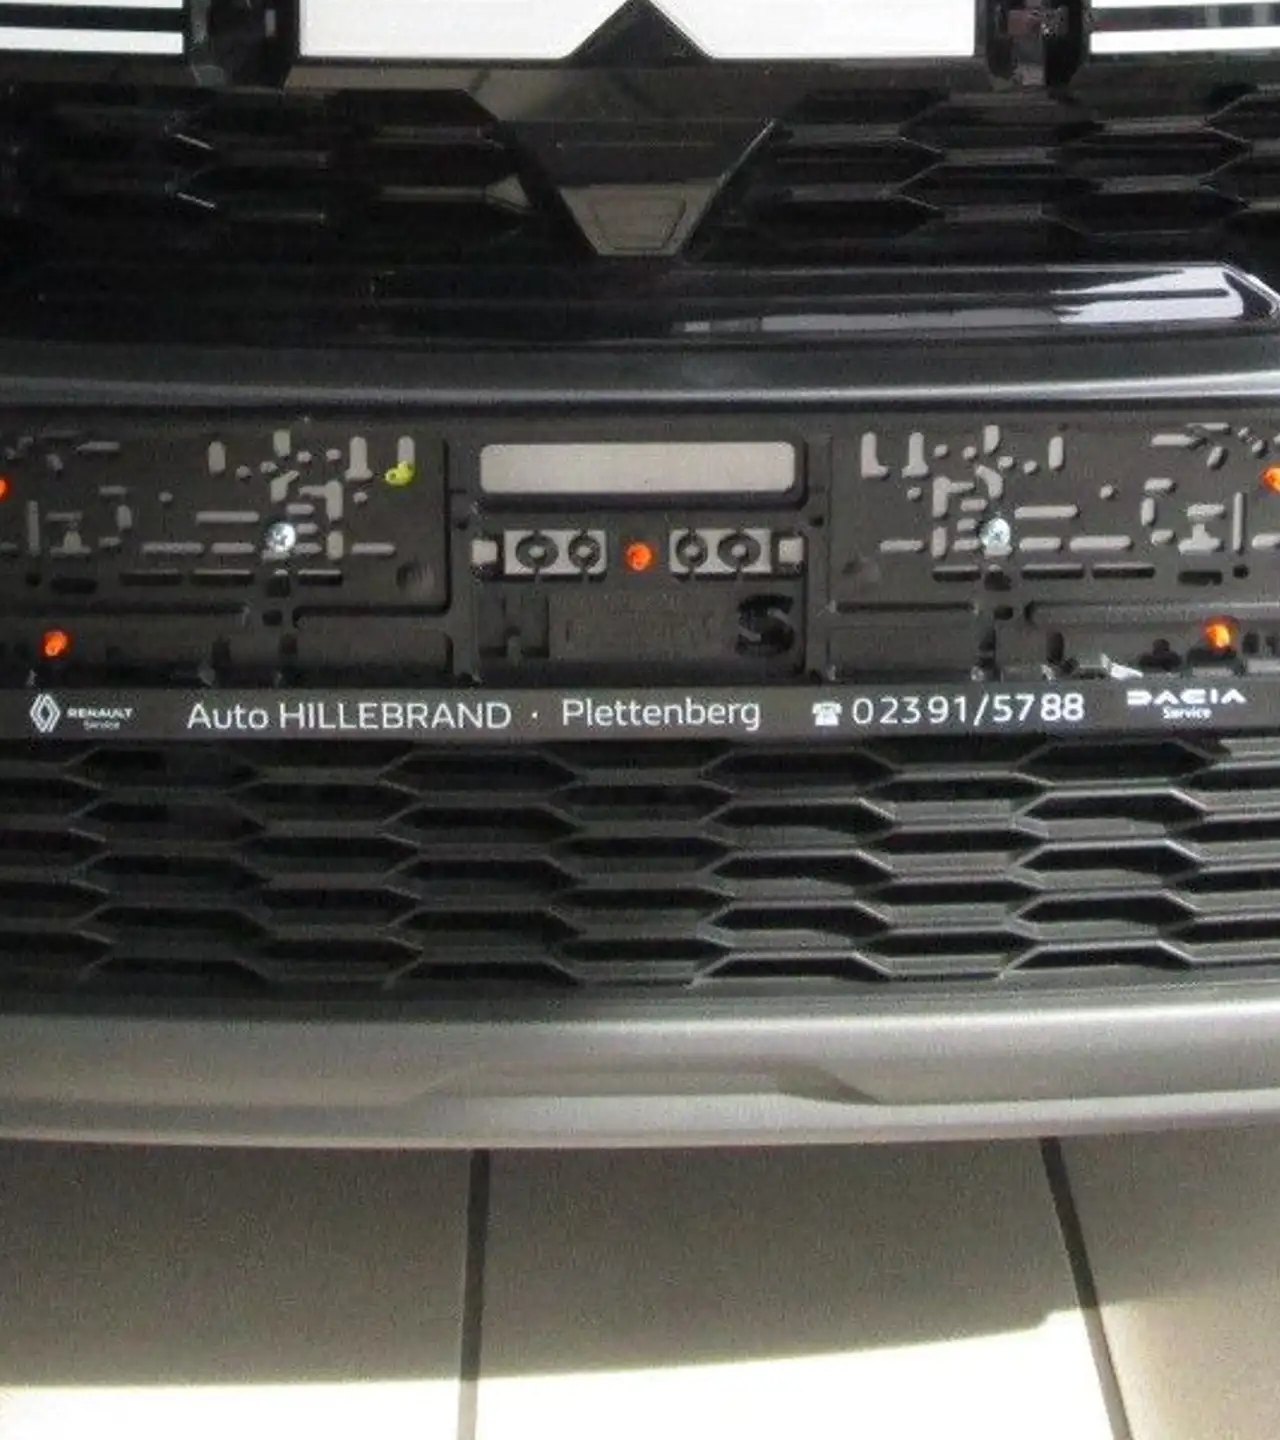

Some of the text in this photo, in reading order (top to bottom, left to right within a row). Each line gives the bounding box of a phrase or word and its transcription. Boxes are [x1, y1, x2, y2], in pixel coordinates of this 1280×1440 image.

[1126, 688, 1247, 705] DACIA
[66, 707, 133, 720] RENAULT
[186, 692, 1085, 732] Auto HILLEBRAND Plettenberg 02391/5788
[1162, 706, 1212, 721] Service
